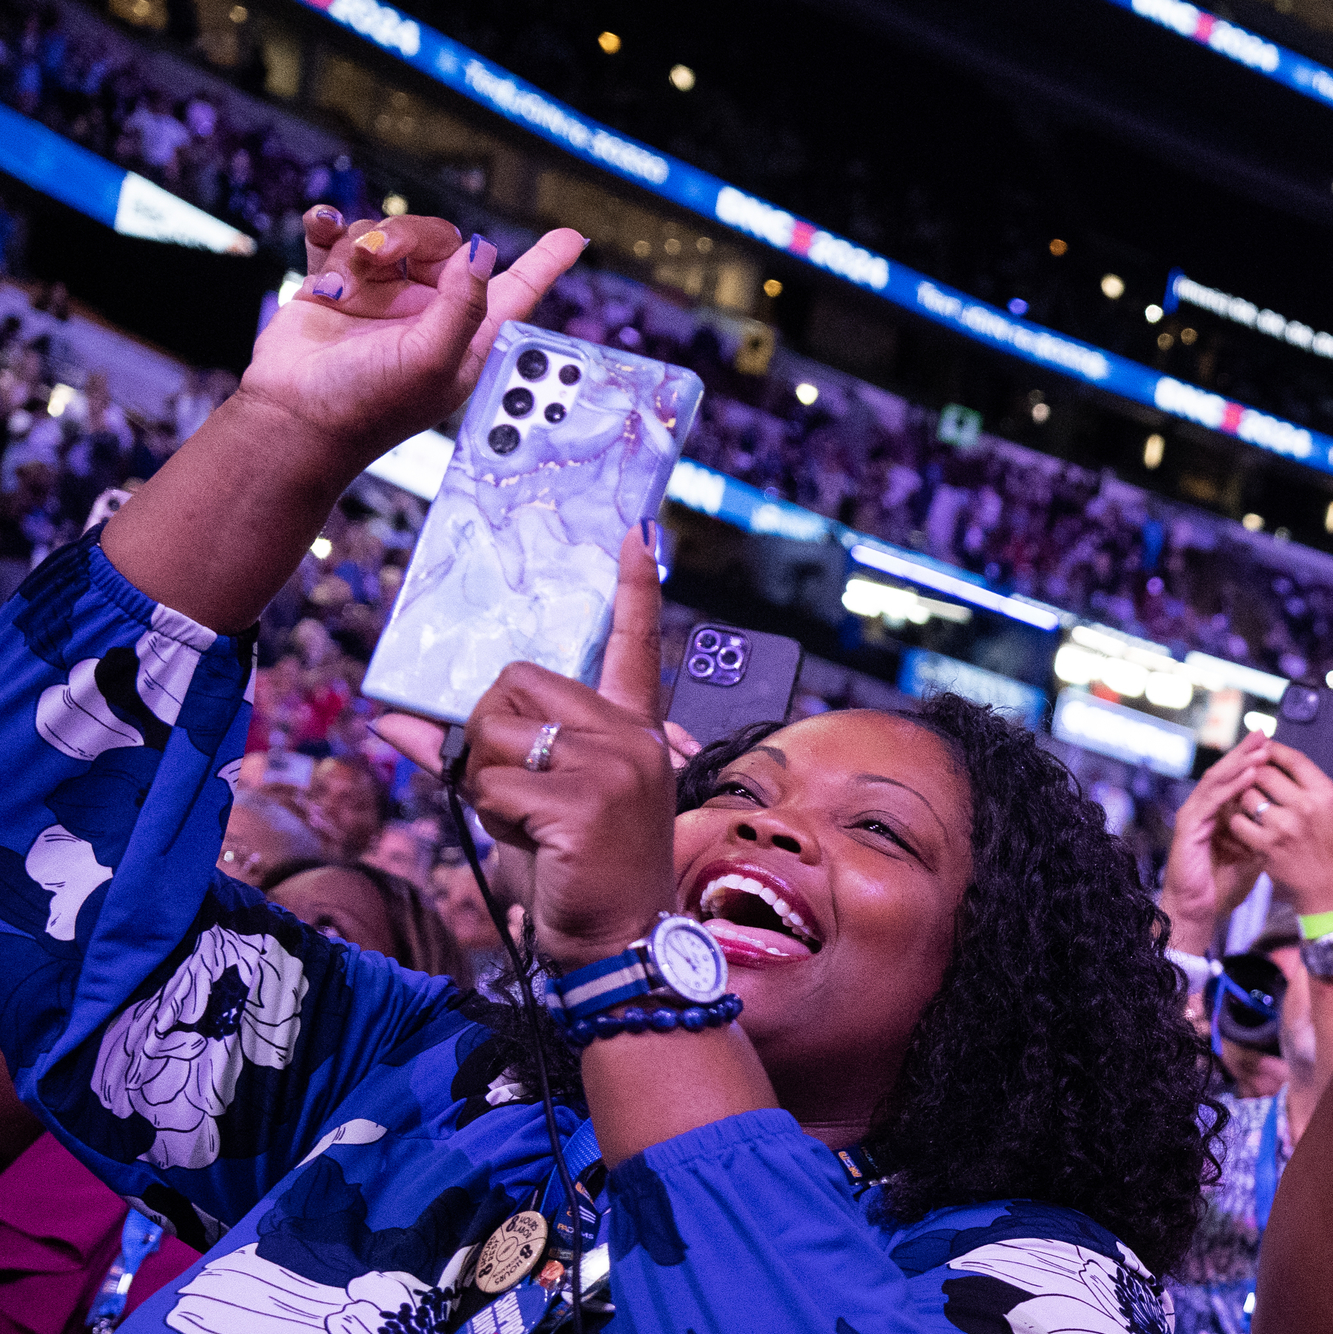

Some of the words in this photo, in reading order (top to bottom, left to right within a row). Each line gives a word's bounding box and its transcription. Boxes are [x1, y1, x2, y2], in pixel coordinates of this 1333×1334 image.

[505, 1215, 520, 1233] 8
[520, 1216, 539, 1232] HOURS
[519, 1243, 533, 1259] 8
[478, 1262, 493, 1279] 8
[494, 1259, 523, 1285] HOURS
